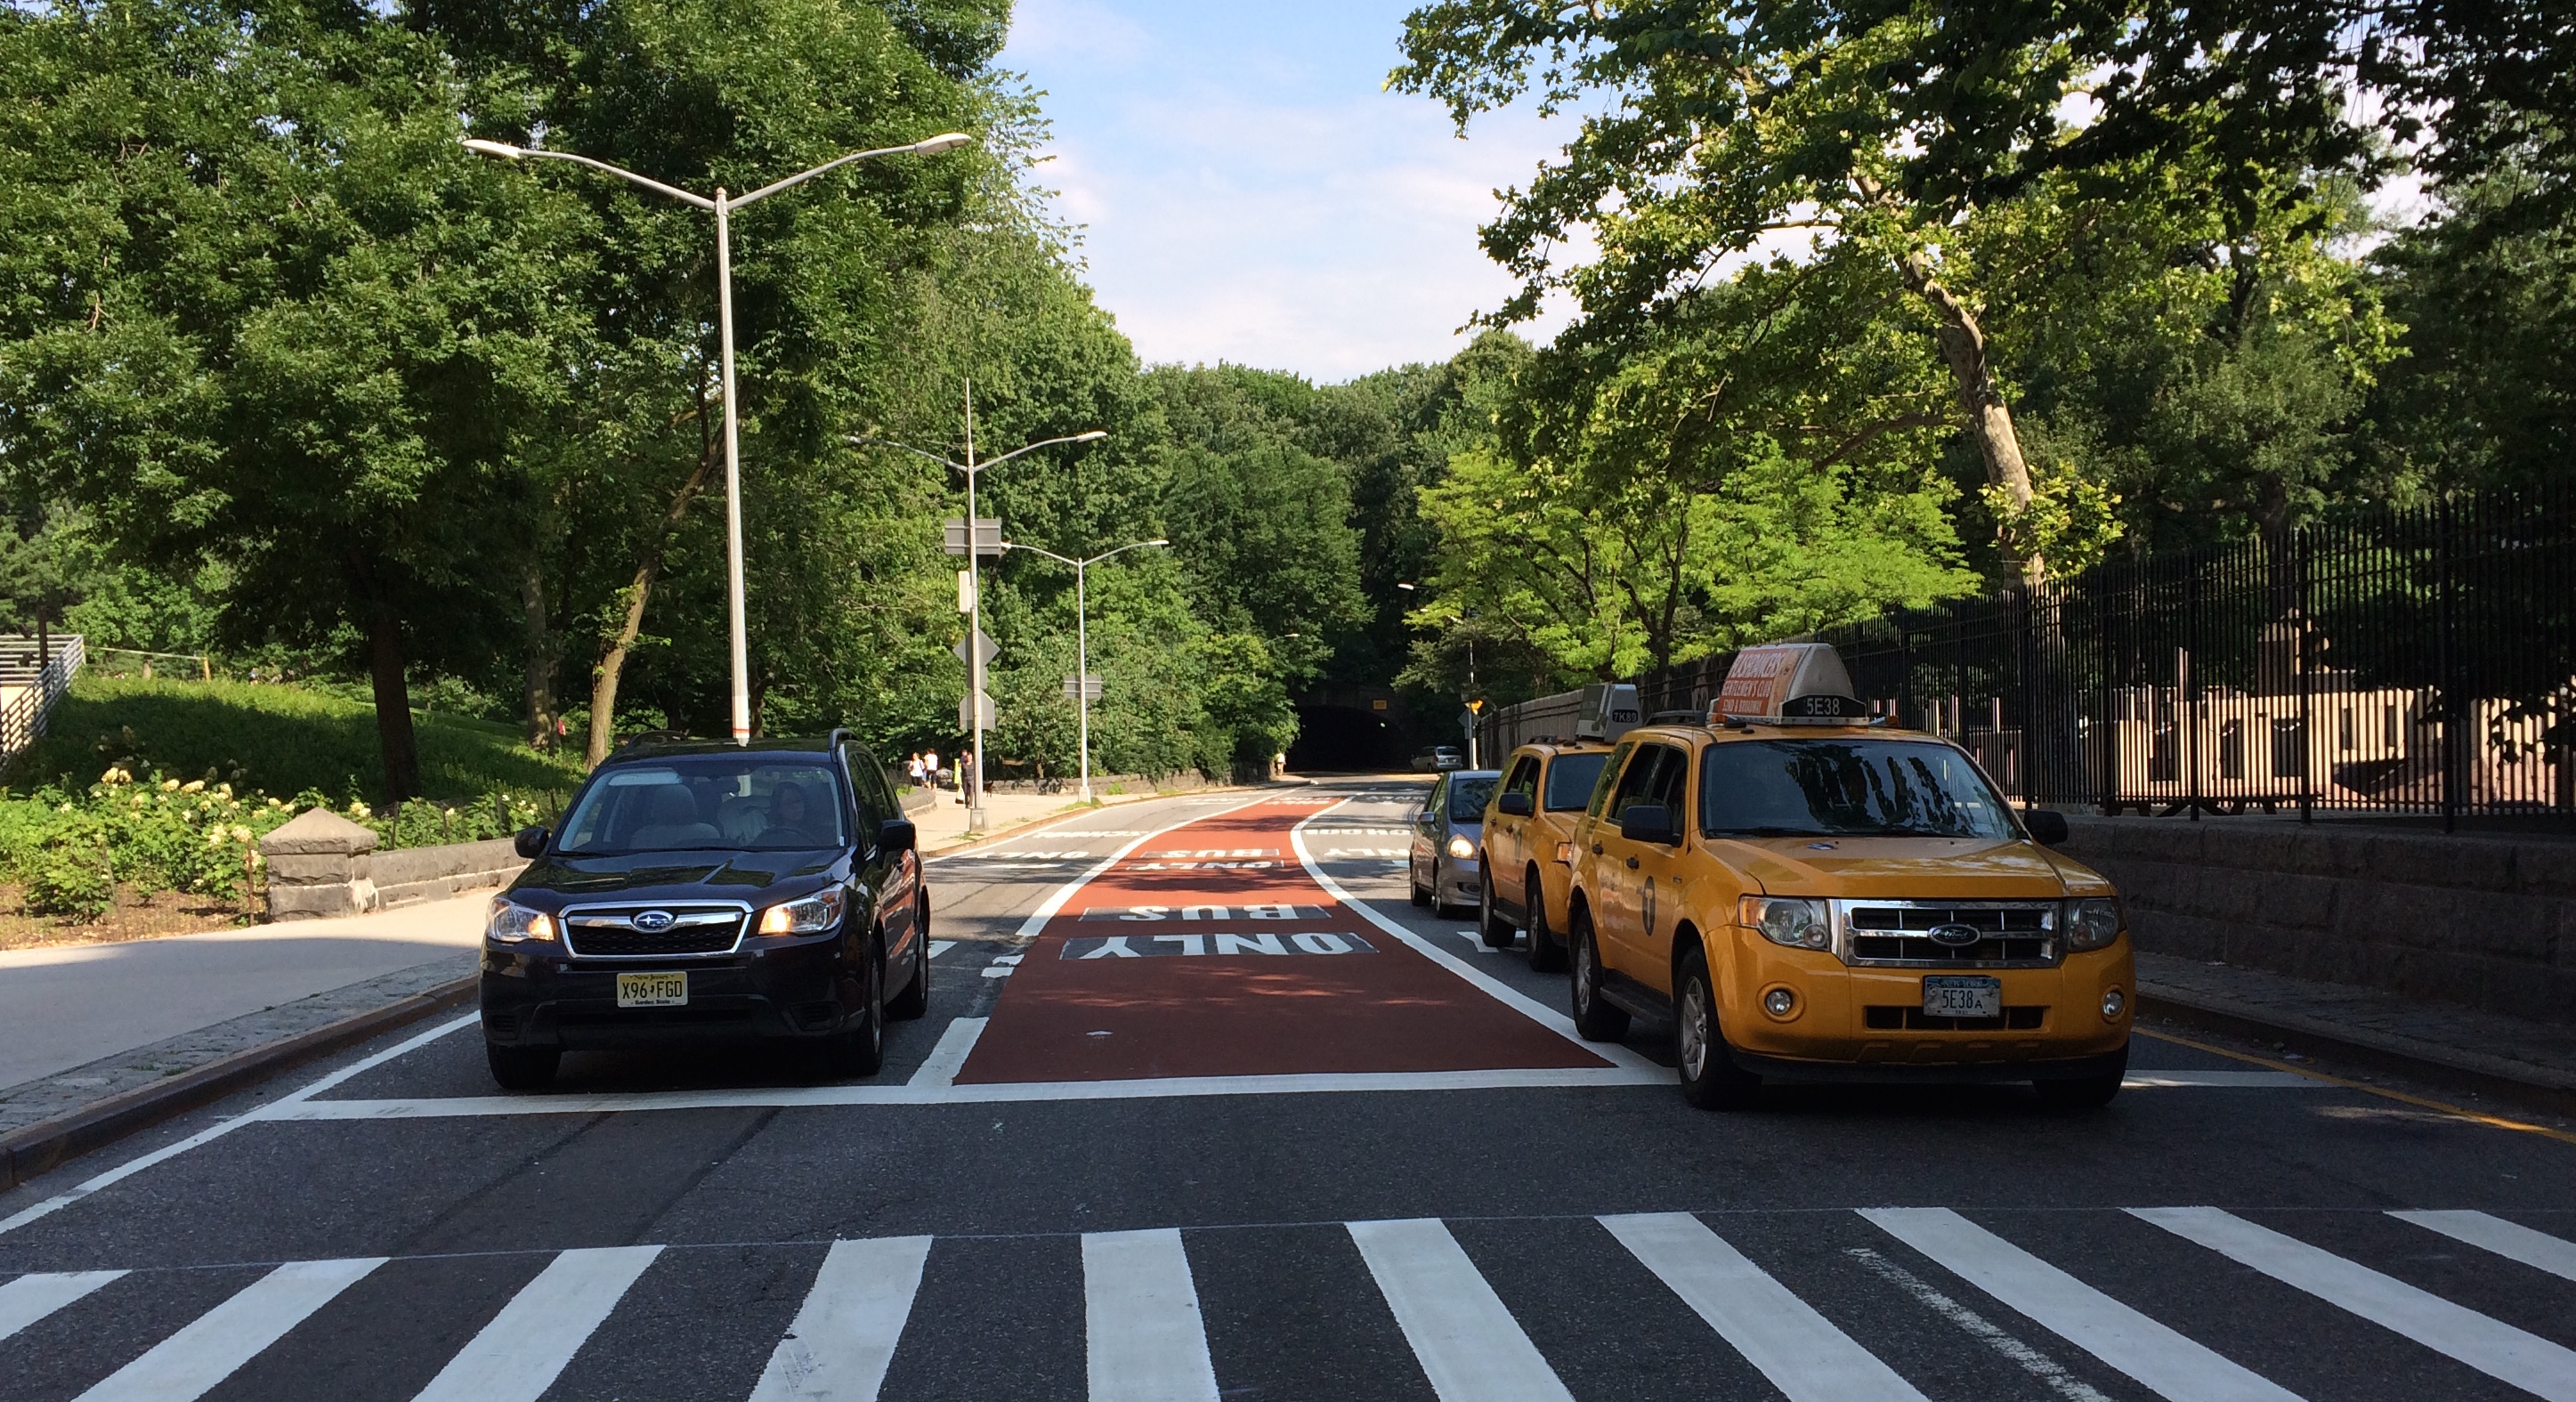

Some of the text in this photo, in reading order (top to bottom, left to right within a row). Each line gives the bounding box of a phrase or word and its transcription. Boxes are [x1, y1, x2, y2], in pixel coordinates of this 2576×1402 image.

[1806, 697, 1841, 716] 5E38
[1613, 711, 1637, 722] 7K89
[1161, 848, 1264, 858] BUS
[1324, 848, 1410, 856] NLY
[1136, 860, 1275, 871] ONLY
[1118, 904, 1300, 921] BUS
[1078, 932, 1355, 959] ONLY
[622, 981, 682, 999] X96 FGD
